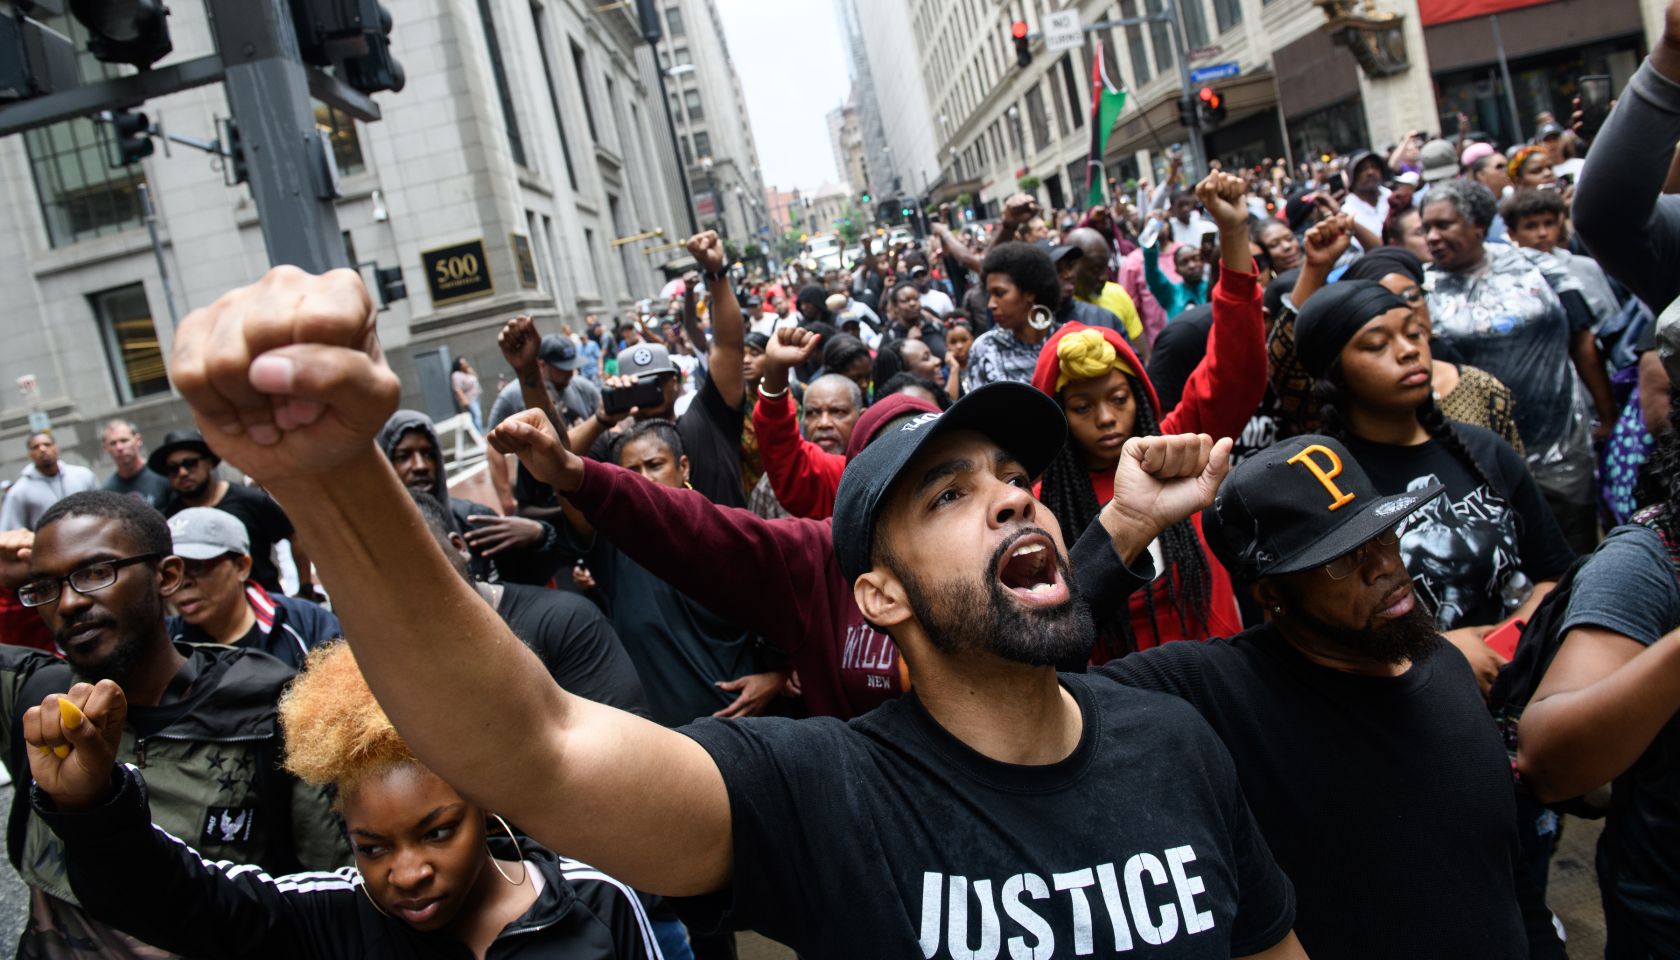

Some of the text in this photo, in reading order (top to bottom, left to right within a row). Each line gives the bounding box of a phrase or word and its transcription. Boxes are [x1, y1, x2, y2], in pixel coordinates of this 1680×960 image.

[1052, 15, 1071, 28] NO
[435, 253, 479, 284] 500
[1286, 444, 1357, 512] P
[867, 674, 891, 689] NEW
[918, 845, 1216, 960] JUSTICE
